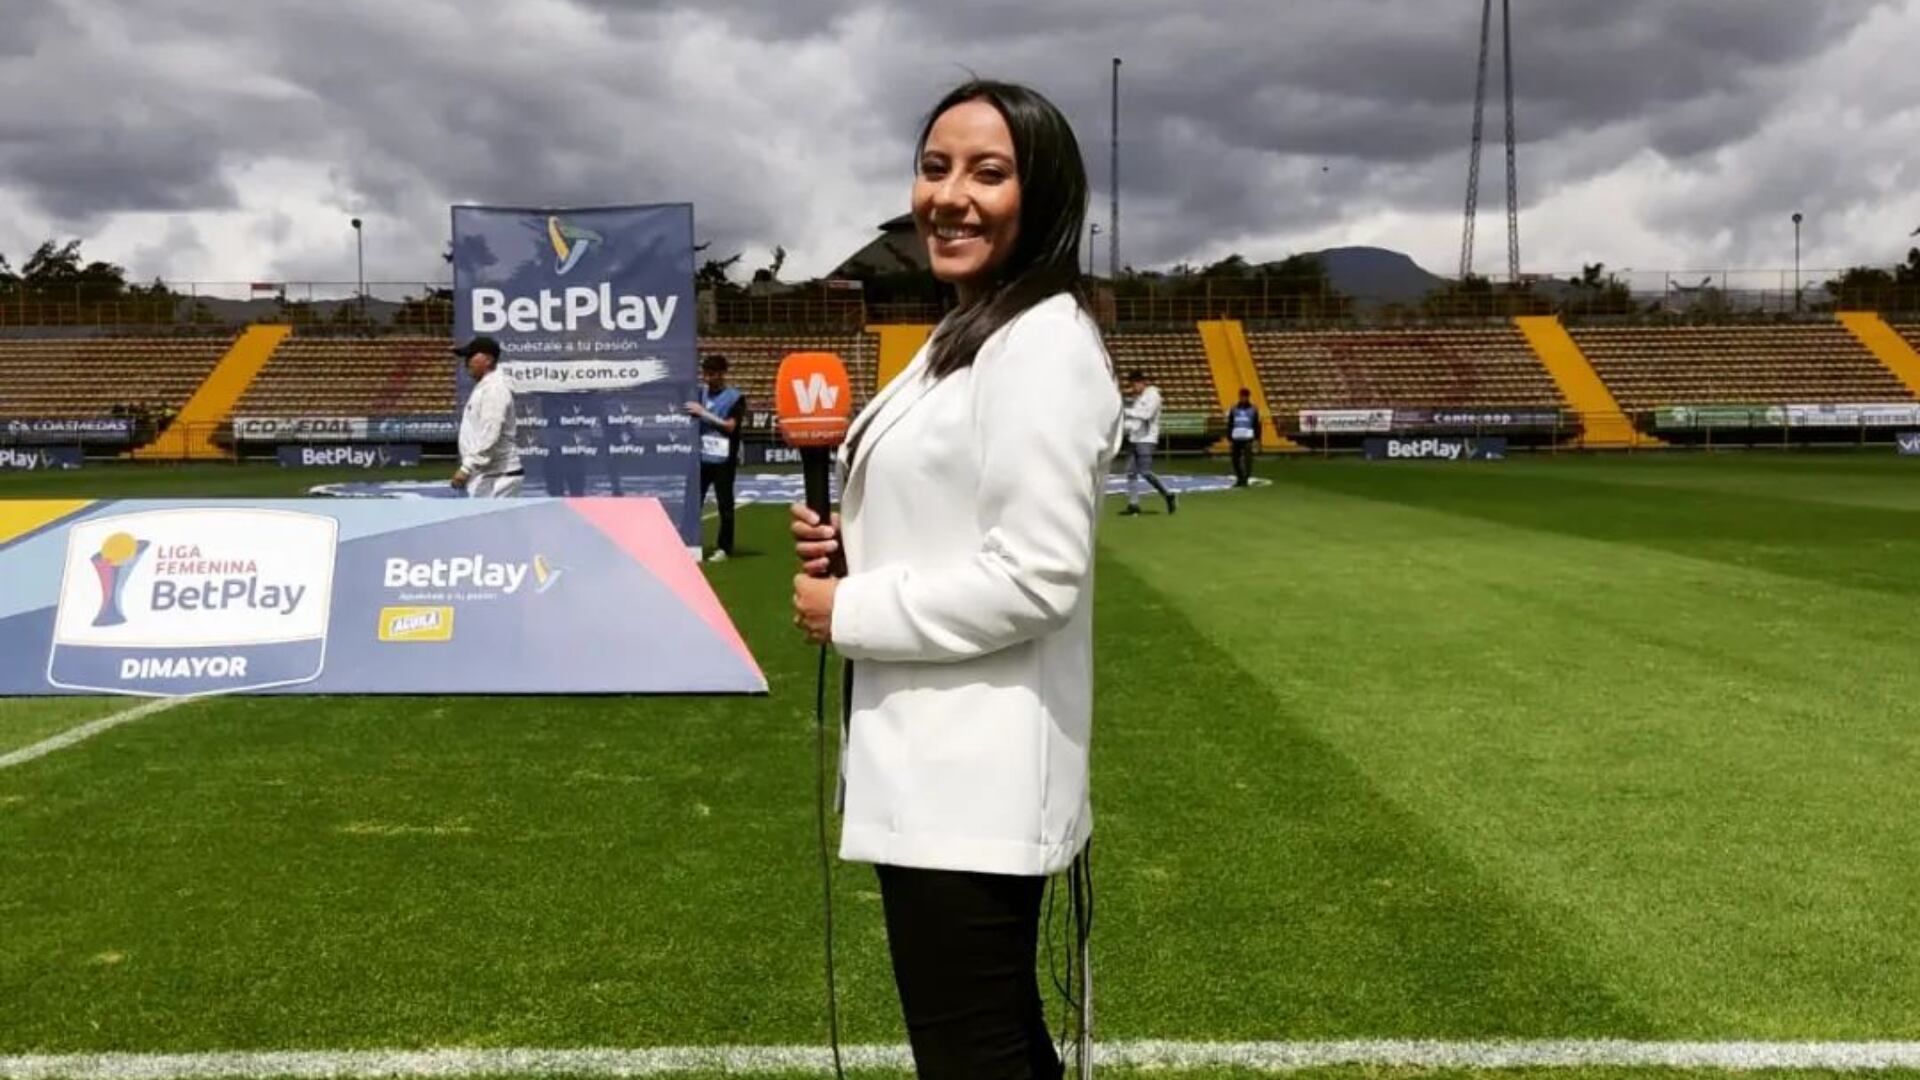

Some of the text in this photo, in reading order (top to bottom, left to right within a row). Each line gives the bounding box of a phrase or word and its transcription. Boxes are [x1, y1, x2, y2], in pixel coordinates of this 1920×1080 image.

[471, 282, 678, 340] BetPlay
[302, 446, 375, 468] BetPlay
[1387, 439, 1462, 459] BetPlay
[157, 545, 201, 559] LIGA
[155, 560, 258, 575] FEMENINA
[383, 554, 528, 593] BetPlay
[150, 578, 306, 615] BetPlay
[120, 656, 248, 679] DIMAYOR
